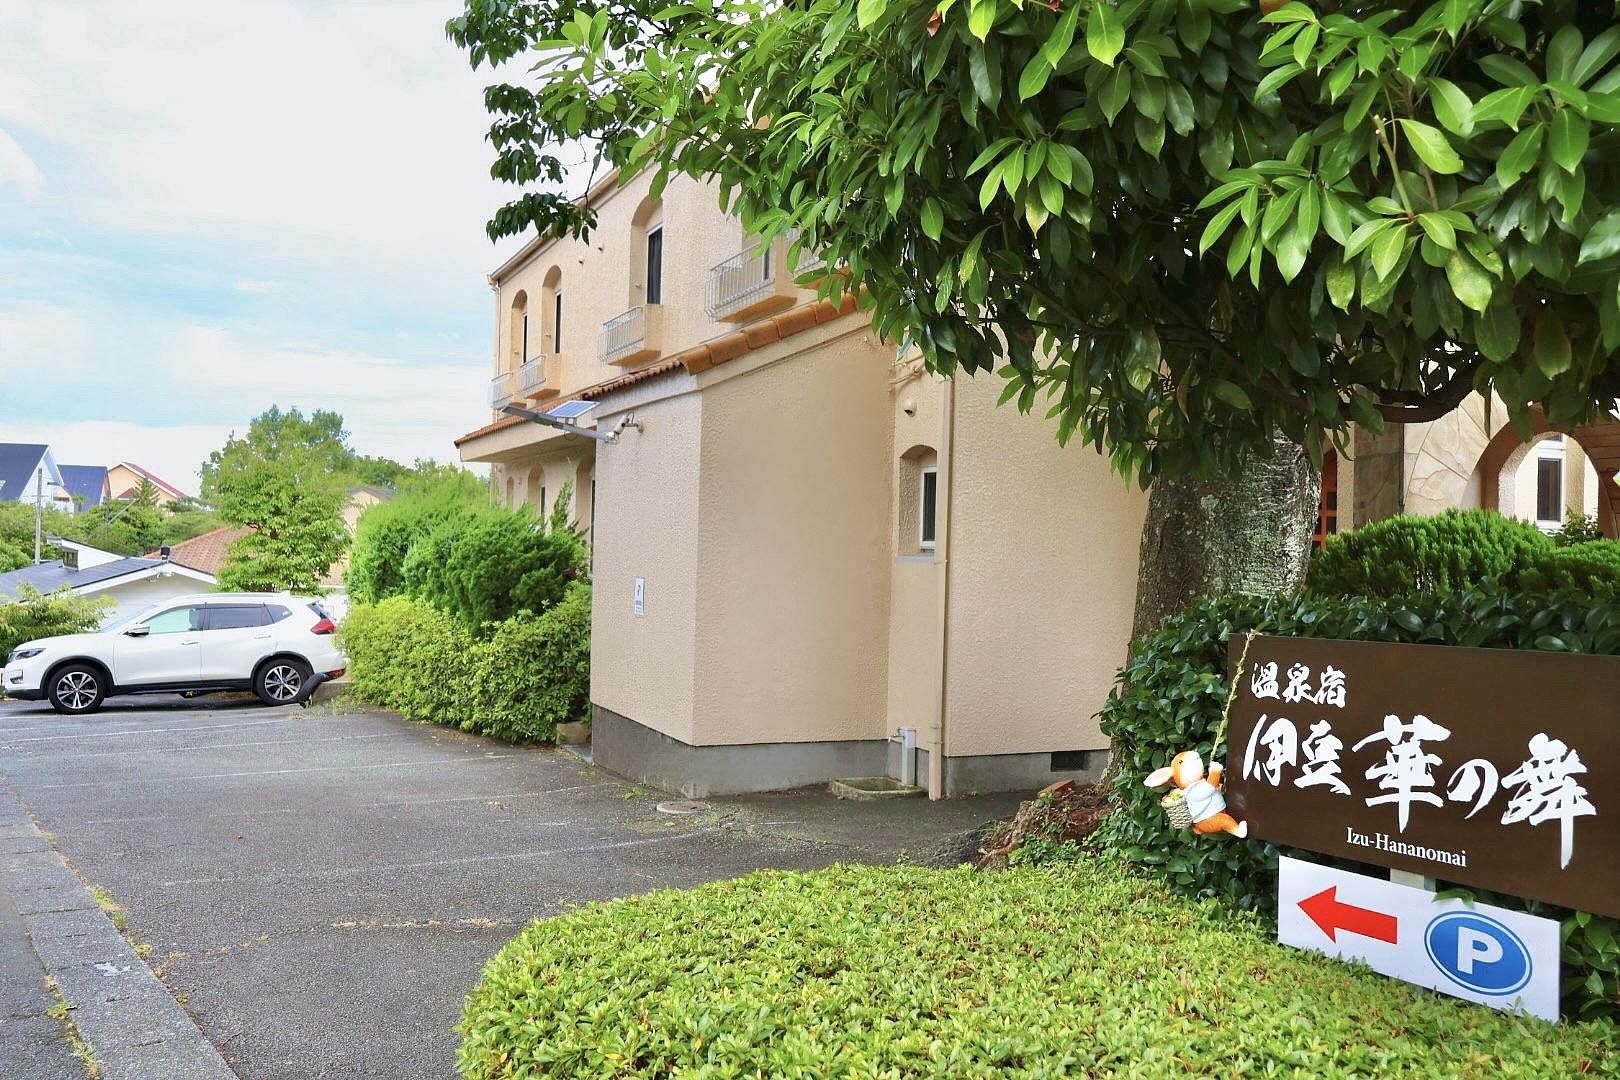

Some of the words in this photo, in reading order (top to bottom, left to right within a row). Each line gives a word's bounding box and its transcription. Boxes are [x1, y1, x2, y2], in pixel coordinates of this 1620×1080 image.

[1251, 661, 1346, 708] 温泉宿
[1243, 714, 1597, 870] 伊豆華の舞
[1346, 827, 1467, 867] Izu-Hananomai
[1457, 926, 1503, 975] P
